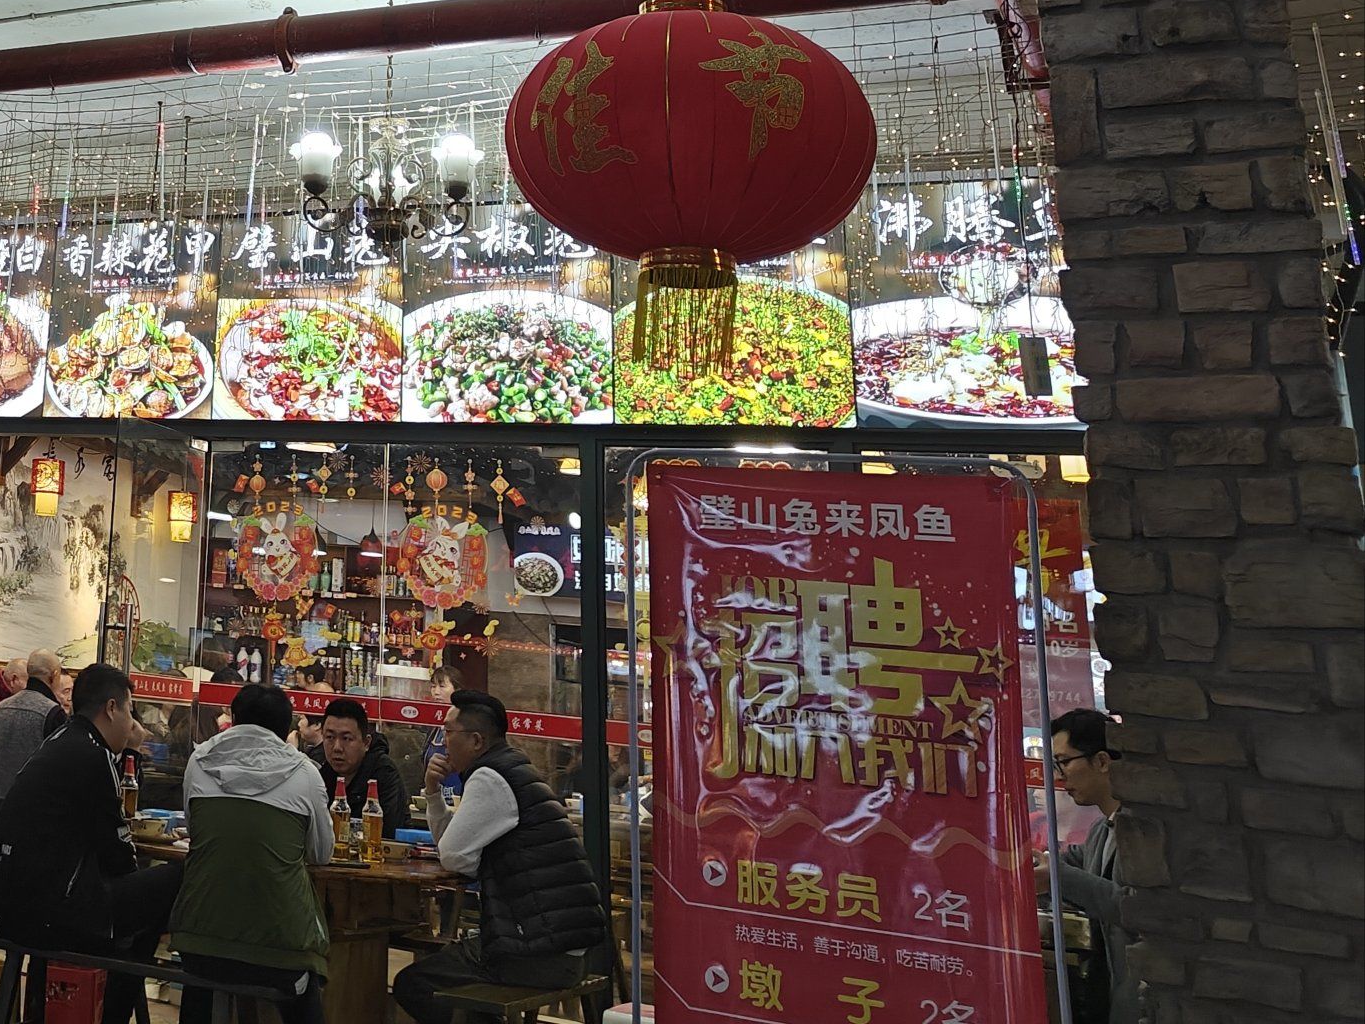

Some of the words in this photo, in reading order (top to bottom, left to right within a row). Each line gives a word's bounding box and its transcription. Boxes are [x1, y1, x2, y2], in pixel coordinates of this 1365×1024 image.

[63, 230, 214, 275] 香辣花甲
[252, 501, 305, 517] 2023
[421, 505, 479, 524] 2023
[700, 495, 955, 543] 璧山兔来凤鱼
[702, 556, 979, 779] 招聘
[511, 717, 545, 732] 家常菜
[742, 706, 933, 740] ADVERTISEMENT
[737, 859, 882, 922] 服务员
[913, 889, 972, 931] 2名
